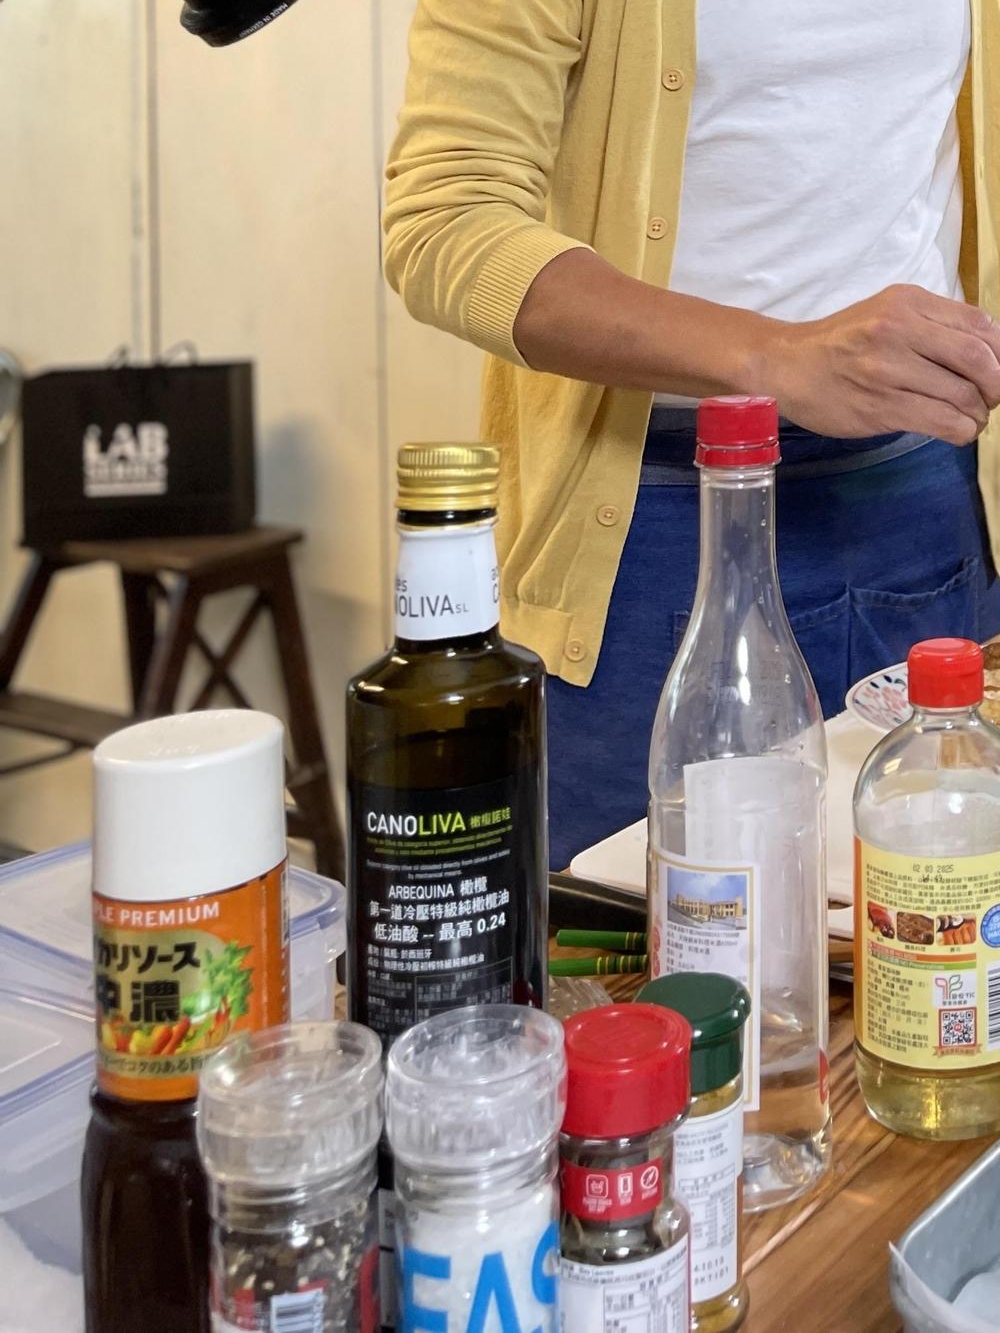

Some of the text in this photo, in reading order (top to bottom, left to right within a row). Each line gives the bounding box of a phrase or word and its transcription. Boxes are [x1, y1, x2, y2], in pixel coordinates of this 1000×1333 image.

[270, 2, 288, 17] MADE
[83, 422, 168, 464] LAB
[367, 811, 466, 836] CANOLIVA
[388, 883, 455, 899] ARBEQUINA
[120, 901, 220, 926] PREMIUM
[369, 889, 510, 921] 第一道冷壓特級純橄欖油
[374, 922, 419, 943] 低油酸
[439, 920, 473, 941] 最高
[477, 912, 506, 934] 0.24
